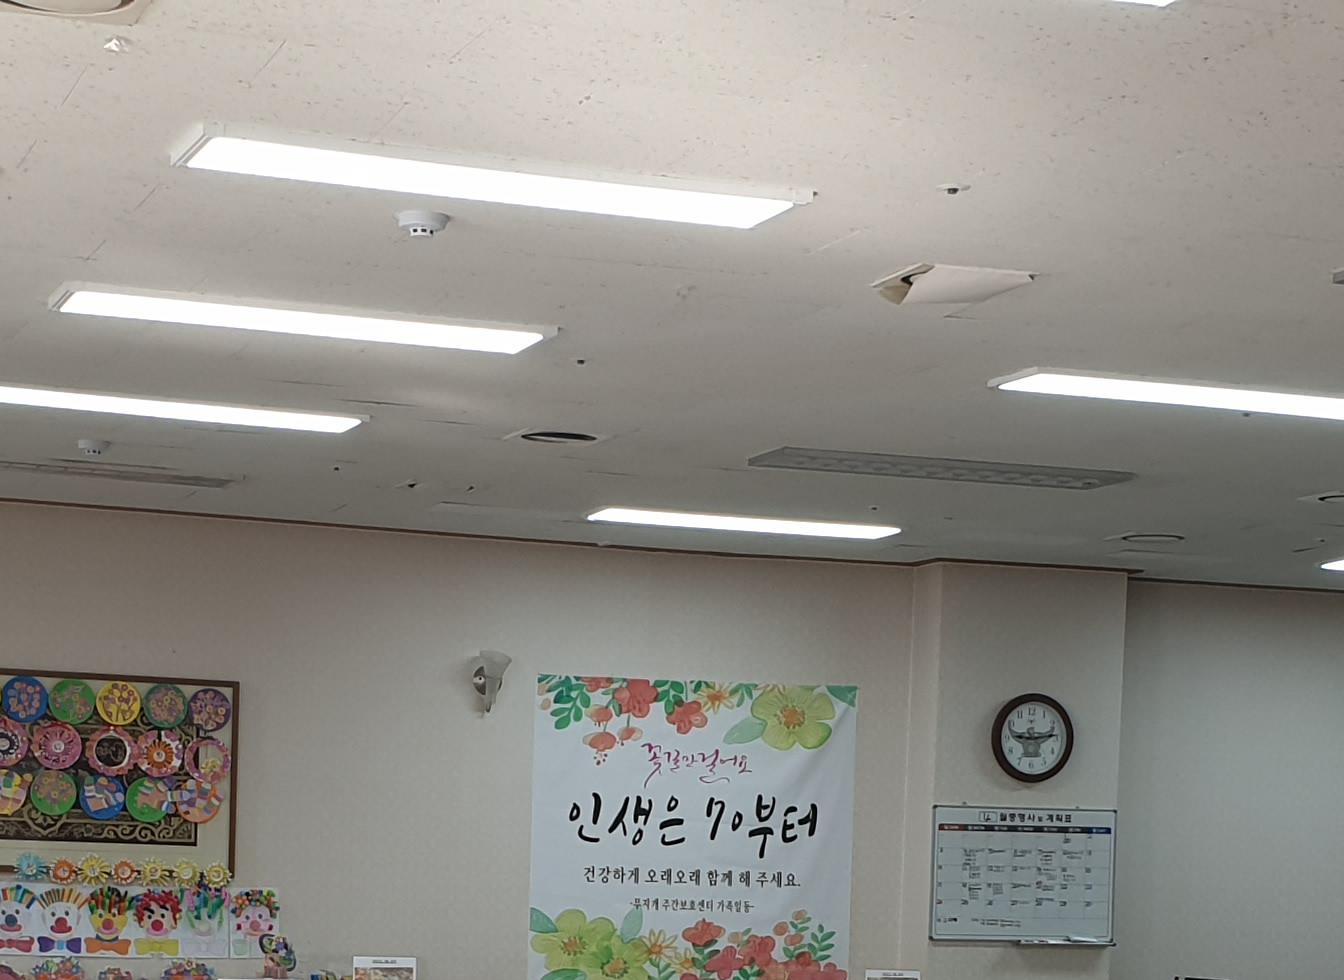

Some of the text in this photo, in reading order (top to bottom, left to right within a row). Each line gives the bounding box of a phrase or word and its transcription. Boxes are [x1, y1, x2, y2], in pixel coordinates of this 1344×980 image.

[569, 792, 818, 859] 인생은 70부터
[583, 866, 801, 888] 건강하게 오래오래 함께 해 주세요.
[662, 898, 714, 912] 주간보호센터
